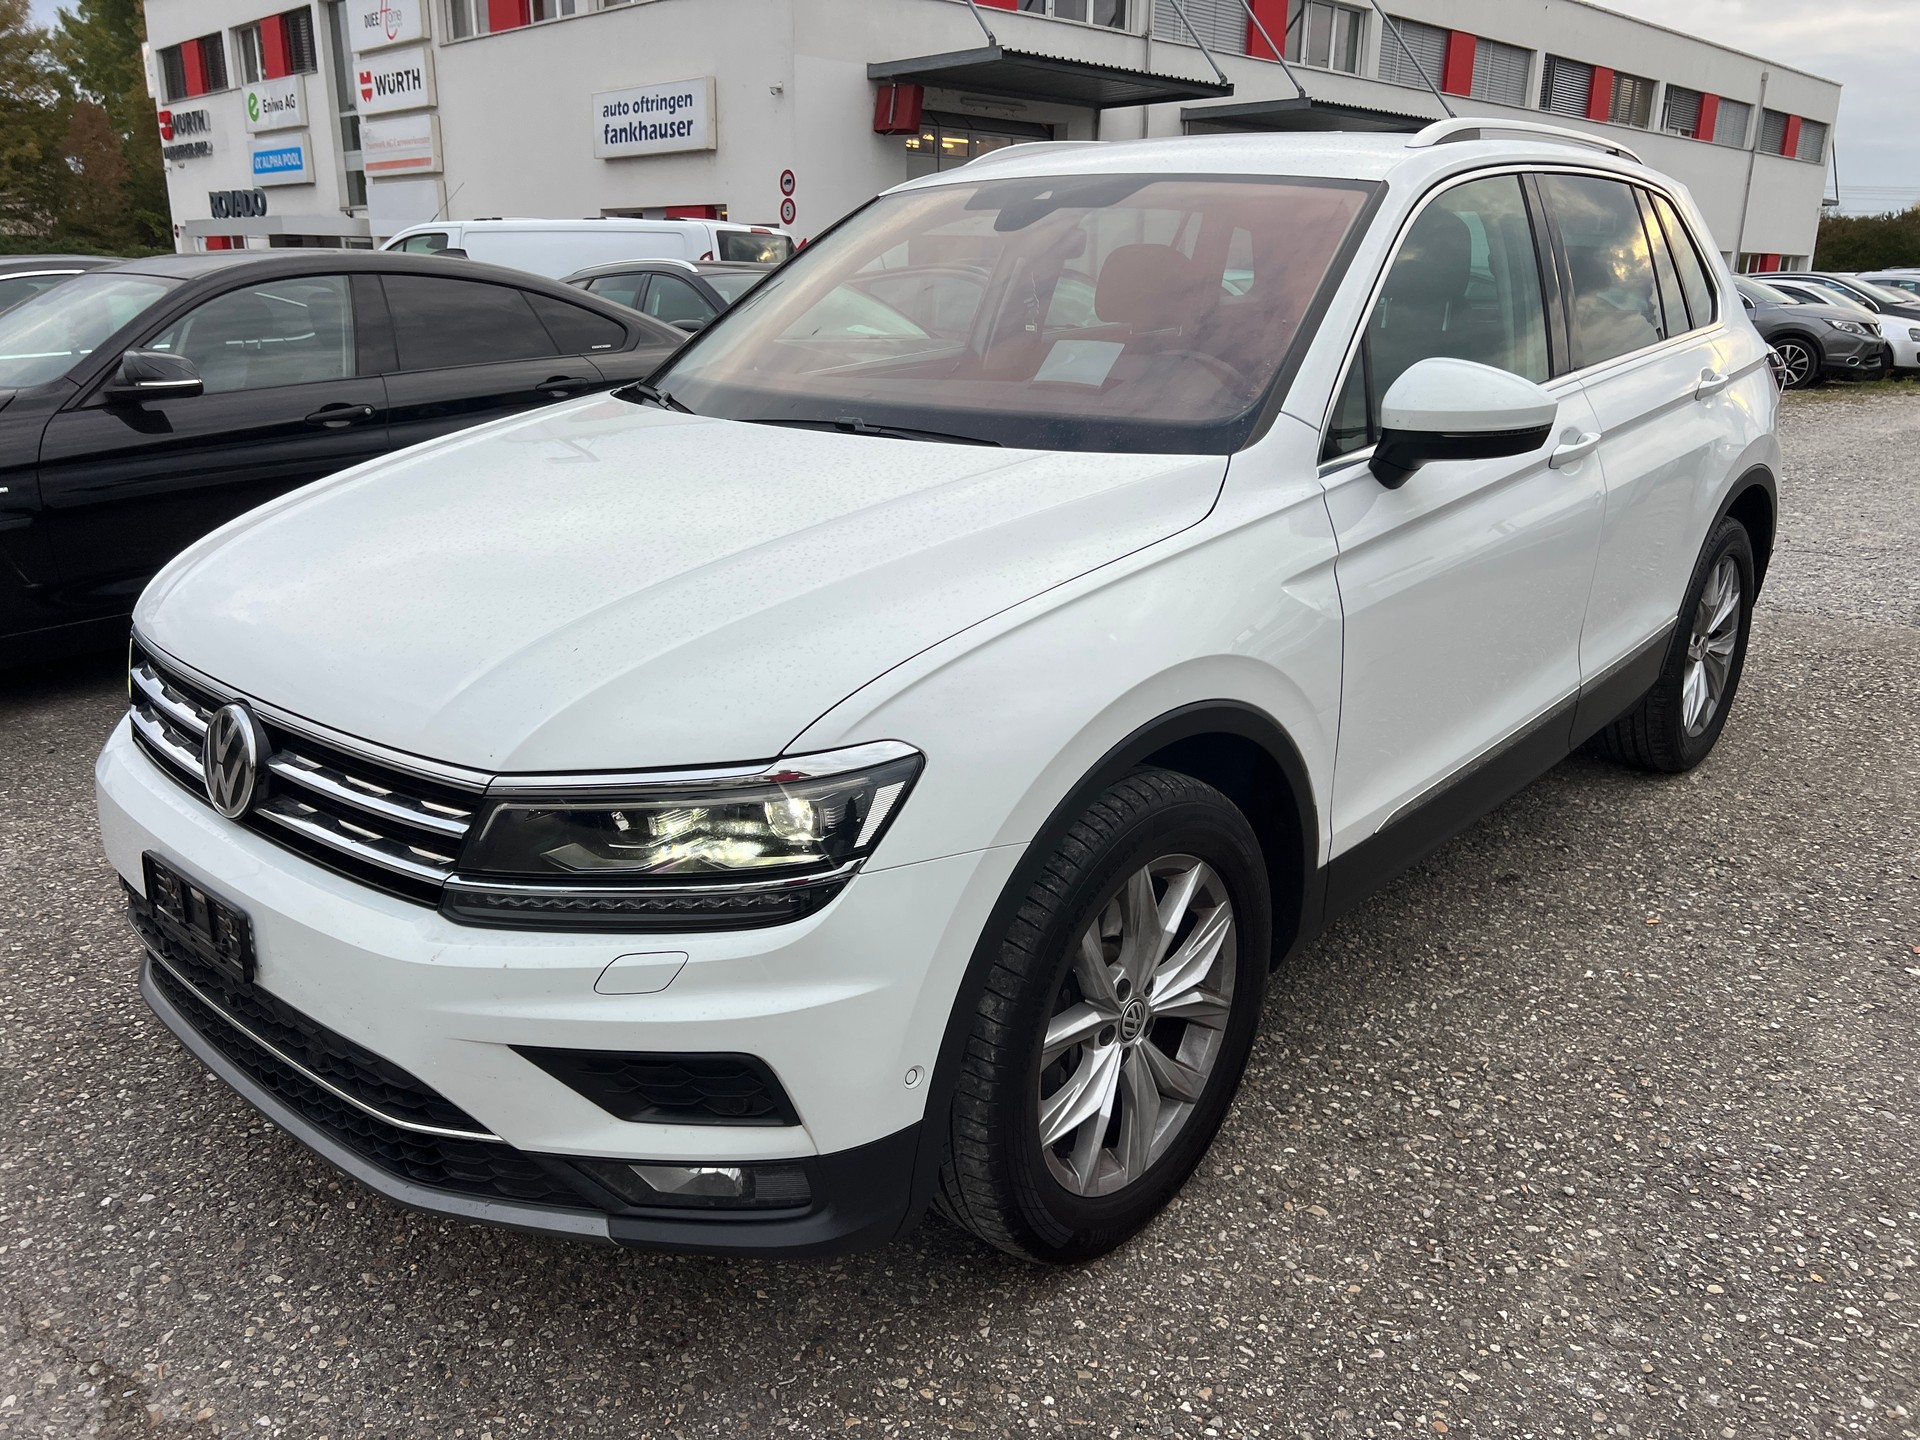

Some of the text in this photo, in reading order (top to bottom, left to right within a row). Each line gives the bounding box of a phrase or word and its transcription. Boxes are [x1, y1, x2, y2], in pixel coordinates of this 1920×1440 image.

[374, 68, 421, 96] WÜRTH
[262, 93, 296, 113] Eniwa AG
[602, 94, 693, 118] auto oftringen
[603, 120, 694, 145] fankhauser
[262, 152, 301, 168] ALPHA POOL
[208, 188, 267, 219] ROVADO
[785, 206, 791, 216] 5
